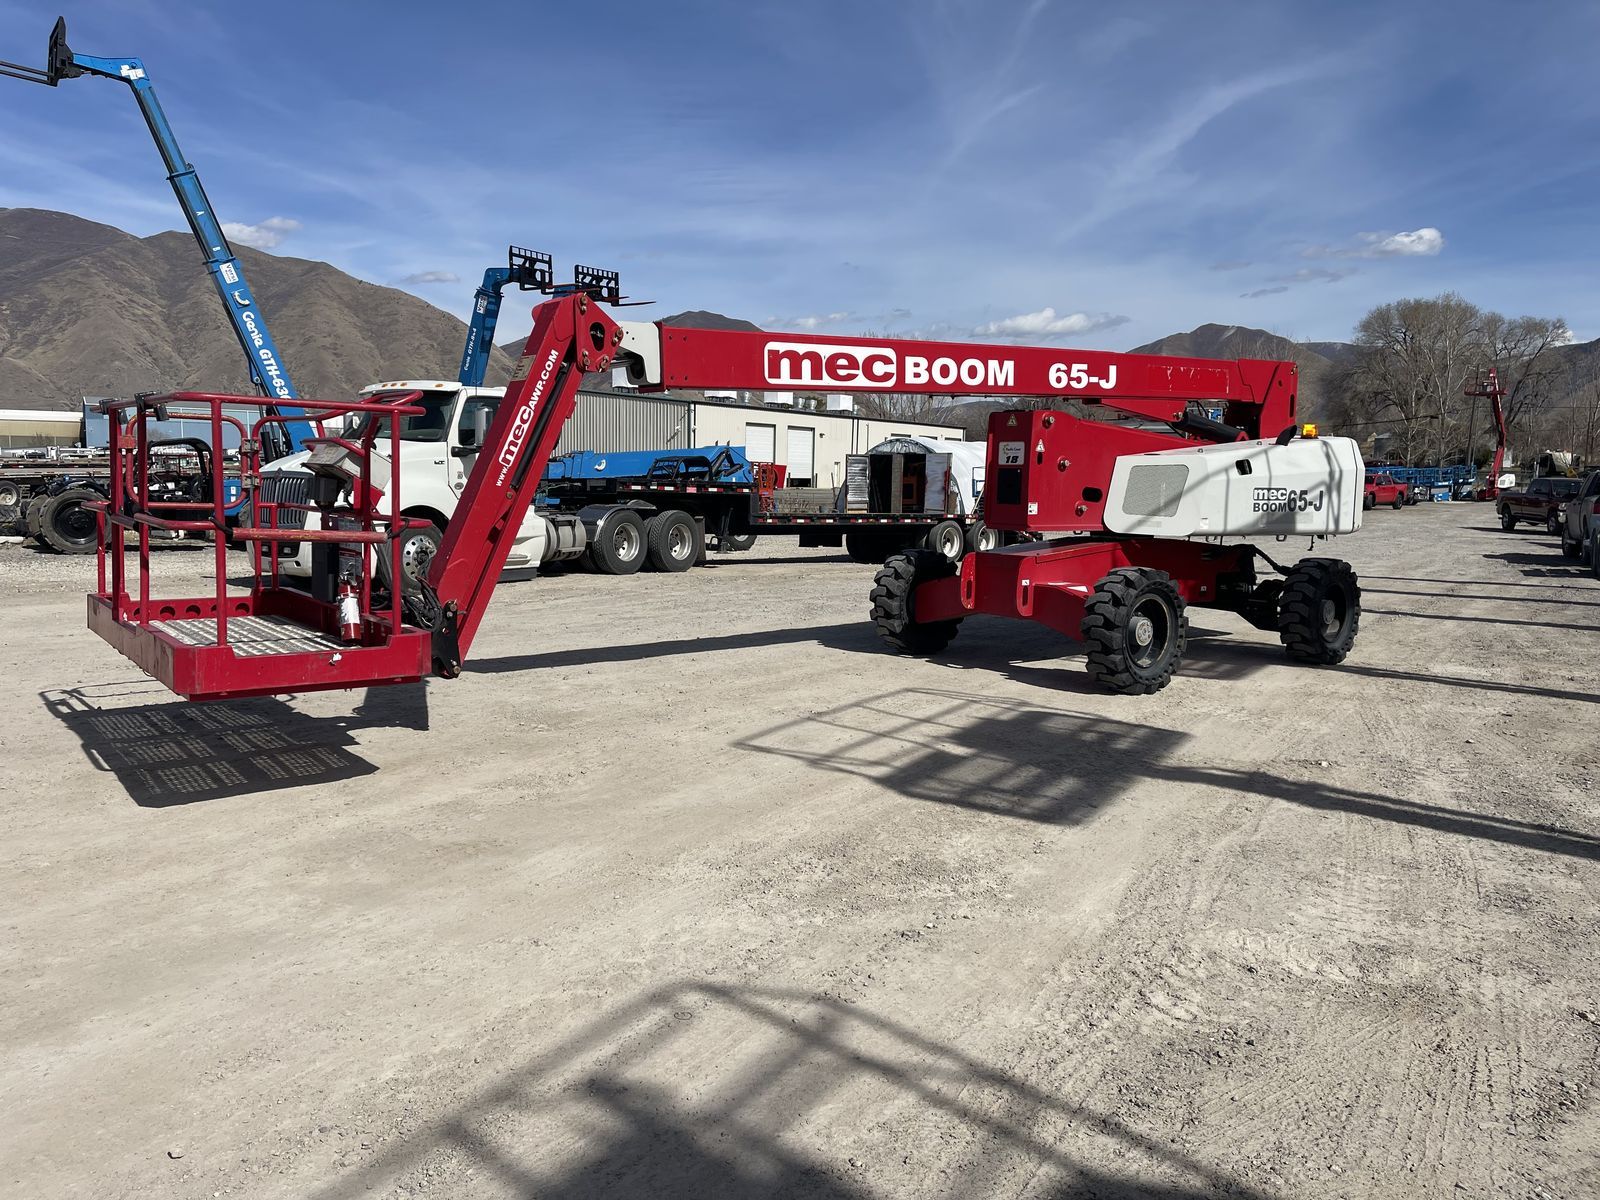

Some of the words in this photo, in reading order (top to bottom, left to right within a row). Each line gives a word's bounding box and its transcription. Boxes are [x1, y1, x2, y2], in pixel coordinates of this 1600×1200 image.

[242, 311, 264, 348] Genie
[767, 349, 895, 383] mec
[905, 355, 1015, 387] BOOM
[1049, 362, 1118, 390] 65-J
[1005, 455, 1019, 463] 18
[1253, 488, 1287, 501] mec
[1287, 489, 1324, 512] 65-J
[1253, 502, 1288, 513] BOOM
